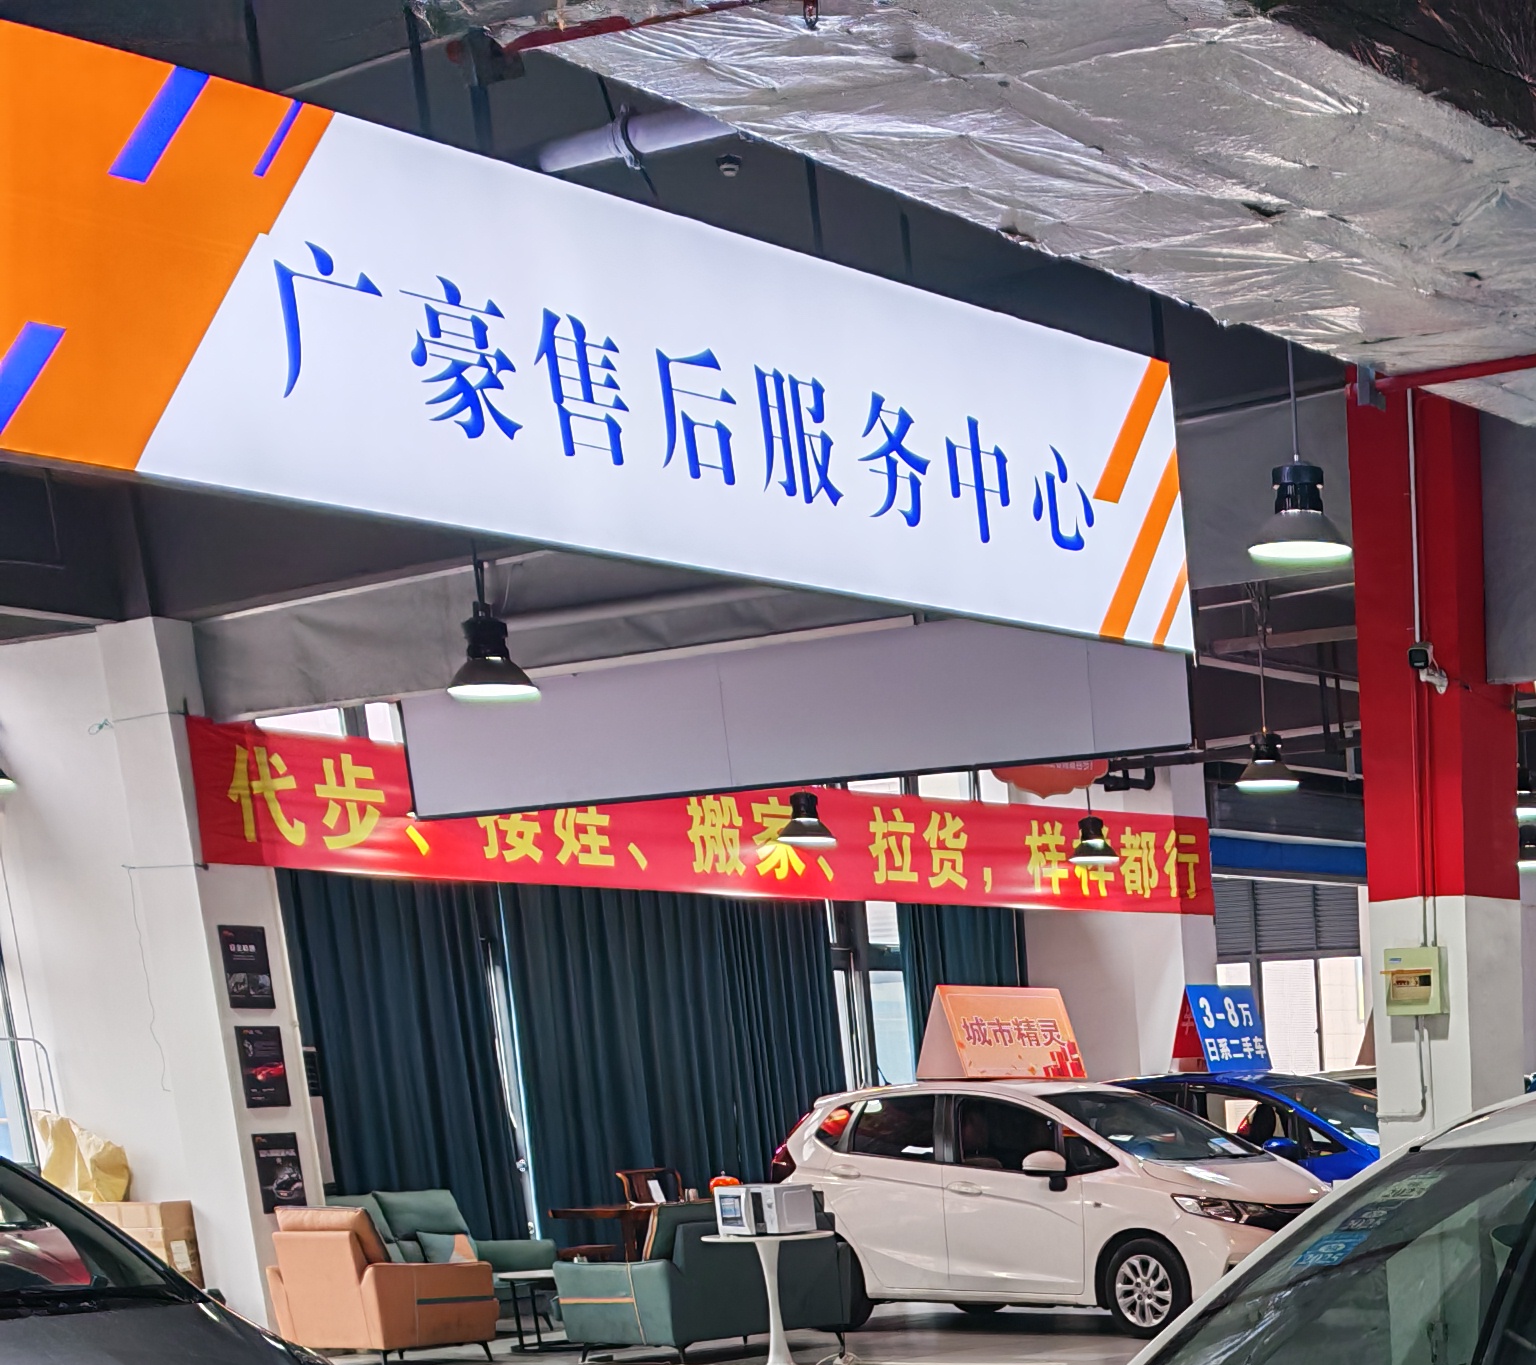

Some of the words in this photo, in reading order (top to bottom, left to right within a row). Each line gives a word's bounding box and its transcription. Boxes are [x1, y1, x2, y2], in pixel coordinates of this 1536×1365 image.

[271, 239, 1096, 553] 广豪售后服务中心
[1199, 996, 1254, 1028] 3-8万
[960, 1015, 1067, 1048] 城市精灵
[1204, 1036, 1267, 1061] 日系二手车
